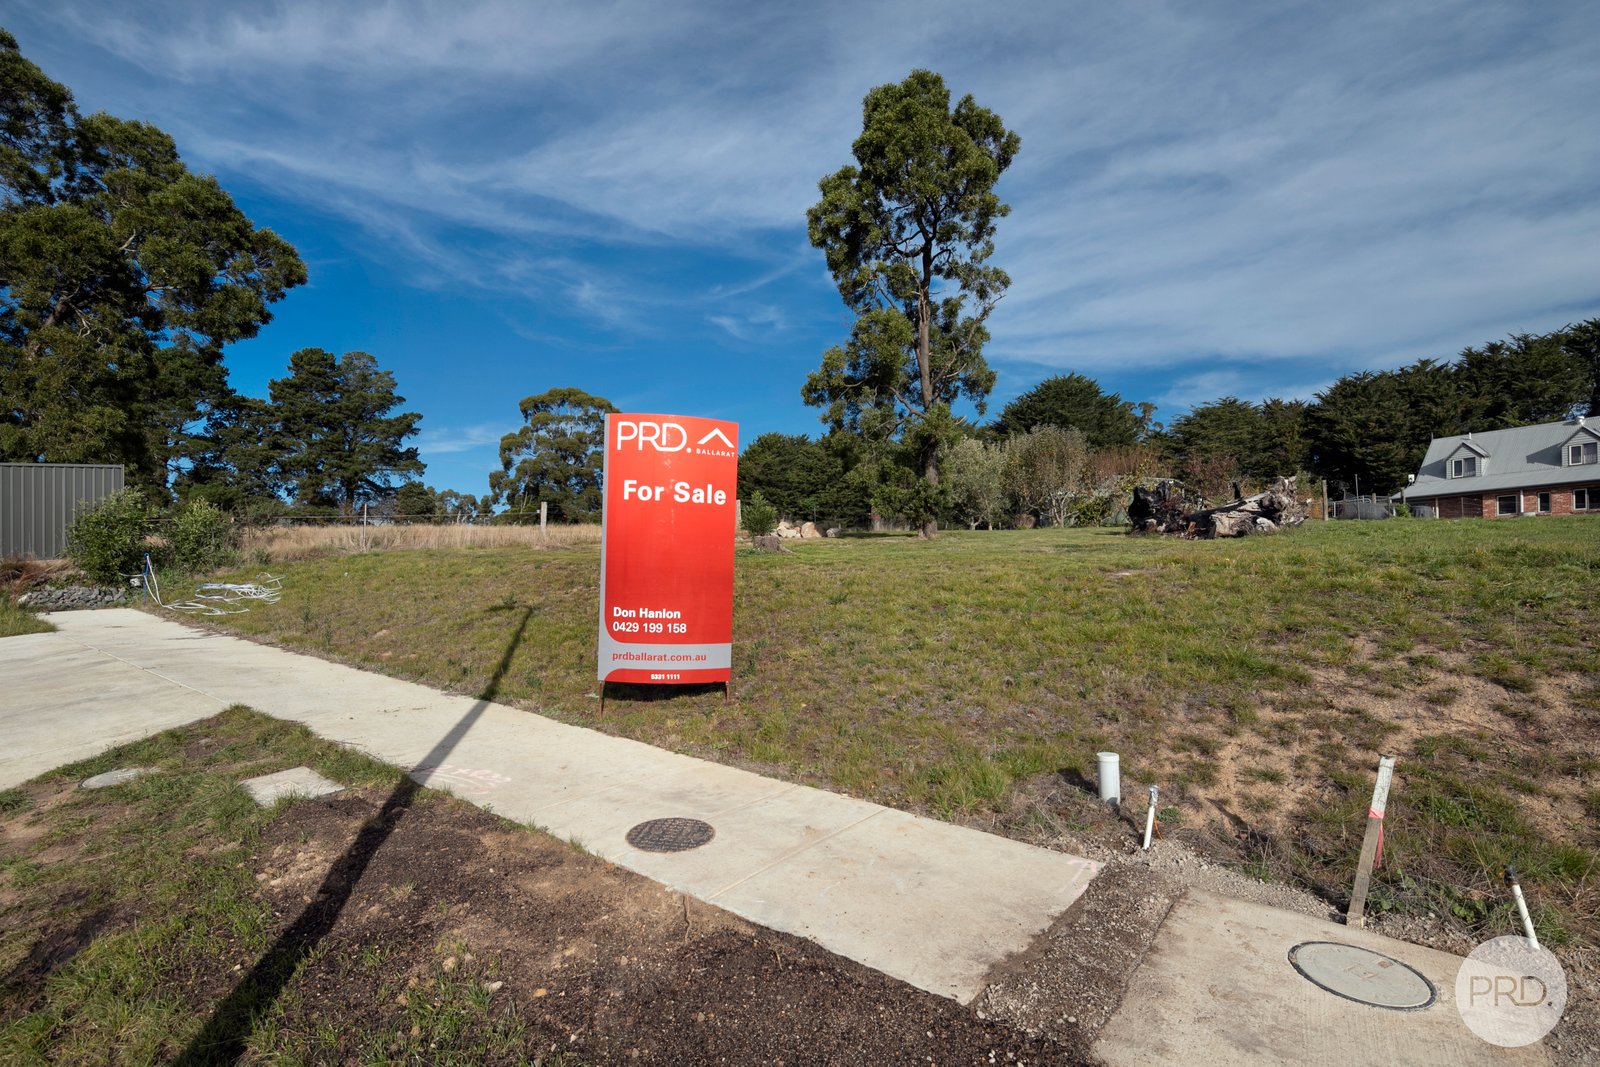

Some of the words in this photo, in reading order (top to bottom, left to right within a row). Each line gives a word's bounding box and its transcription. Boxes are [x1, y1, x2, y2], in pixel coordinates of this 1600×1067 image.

[696, 447, 735, 458] BALLARAT
[623, 479, 664, 501] For
[673, 481, 727, 505] Sale
[613, 606, 636, 618] Don
[639, 607, 681, 619] Hanlon
[612, 621, 639, 633] 0429
[643, 623, 663, 633] 199
[667, 623, 687, 634] 158
[612, 652, 707, 662] prdballarat.com.au
